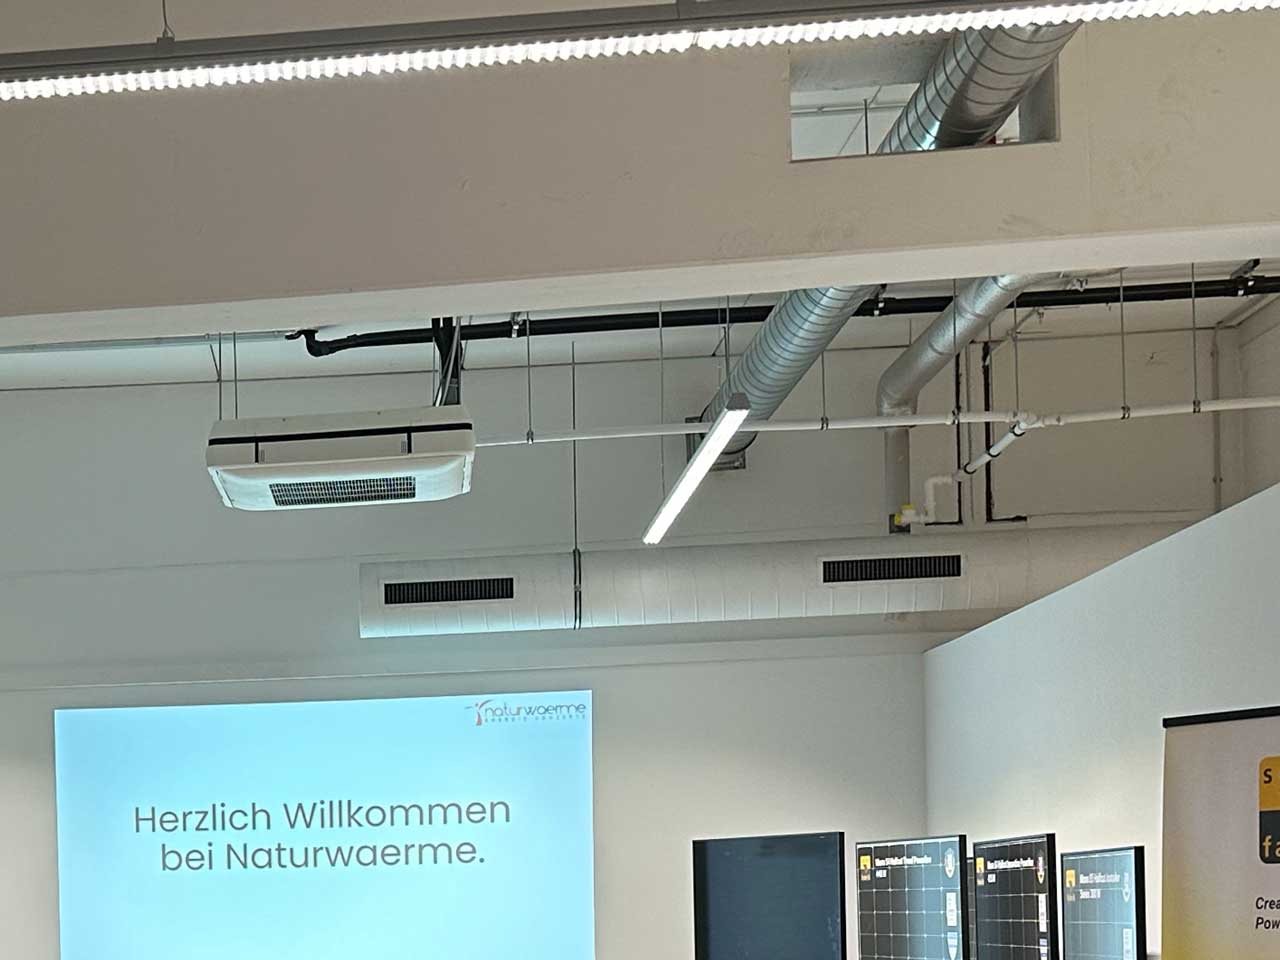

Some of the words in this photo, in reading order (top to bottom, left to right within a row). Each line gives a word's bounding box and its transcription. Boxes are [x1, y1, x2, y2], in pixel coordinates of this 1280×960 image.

[134, 802, 271, 833] Herzlich
[283, 798, 511, 830] Willkommen
[161, 841, 214, 871] bei
[227, 839, 486, 869] Naturwaerme.
